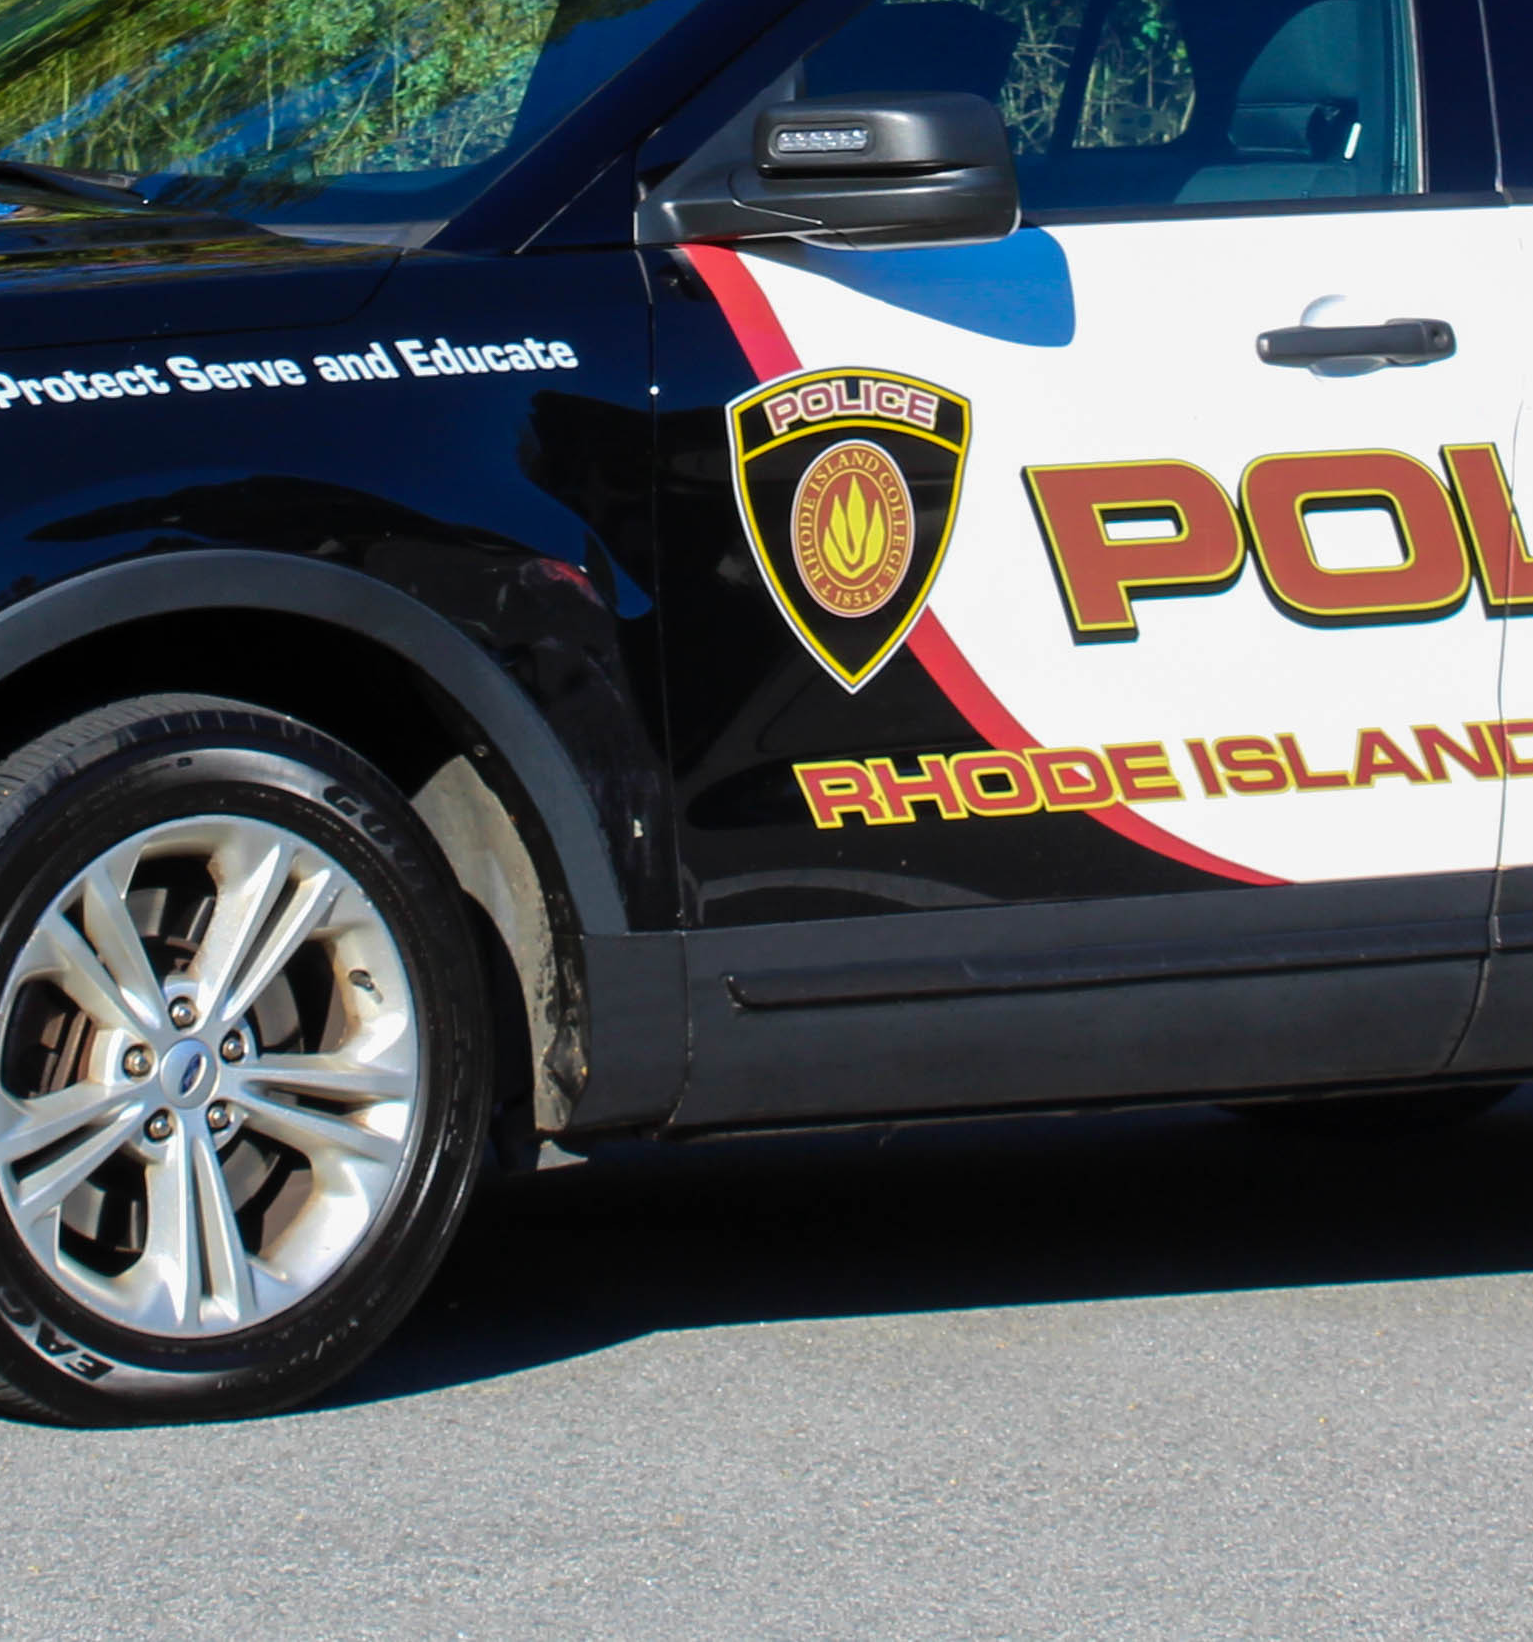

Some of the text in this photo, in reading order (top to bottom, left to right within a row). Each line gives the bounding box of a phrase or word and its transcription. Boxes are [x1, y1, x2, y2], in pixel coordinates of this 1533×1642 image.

[166, 356, 306, 392] Serve
[313, 342, 399, 382] and
[393, 337, 579, 377] Educate
[763, 379, 940, 437] POLICE
[800, 451, 906, 582] RHODE ISLAND COLLEGE
[834, 589, 873, 608] 1854
[794, 739, 1185, 829] RHODE
